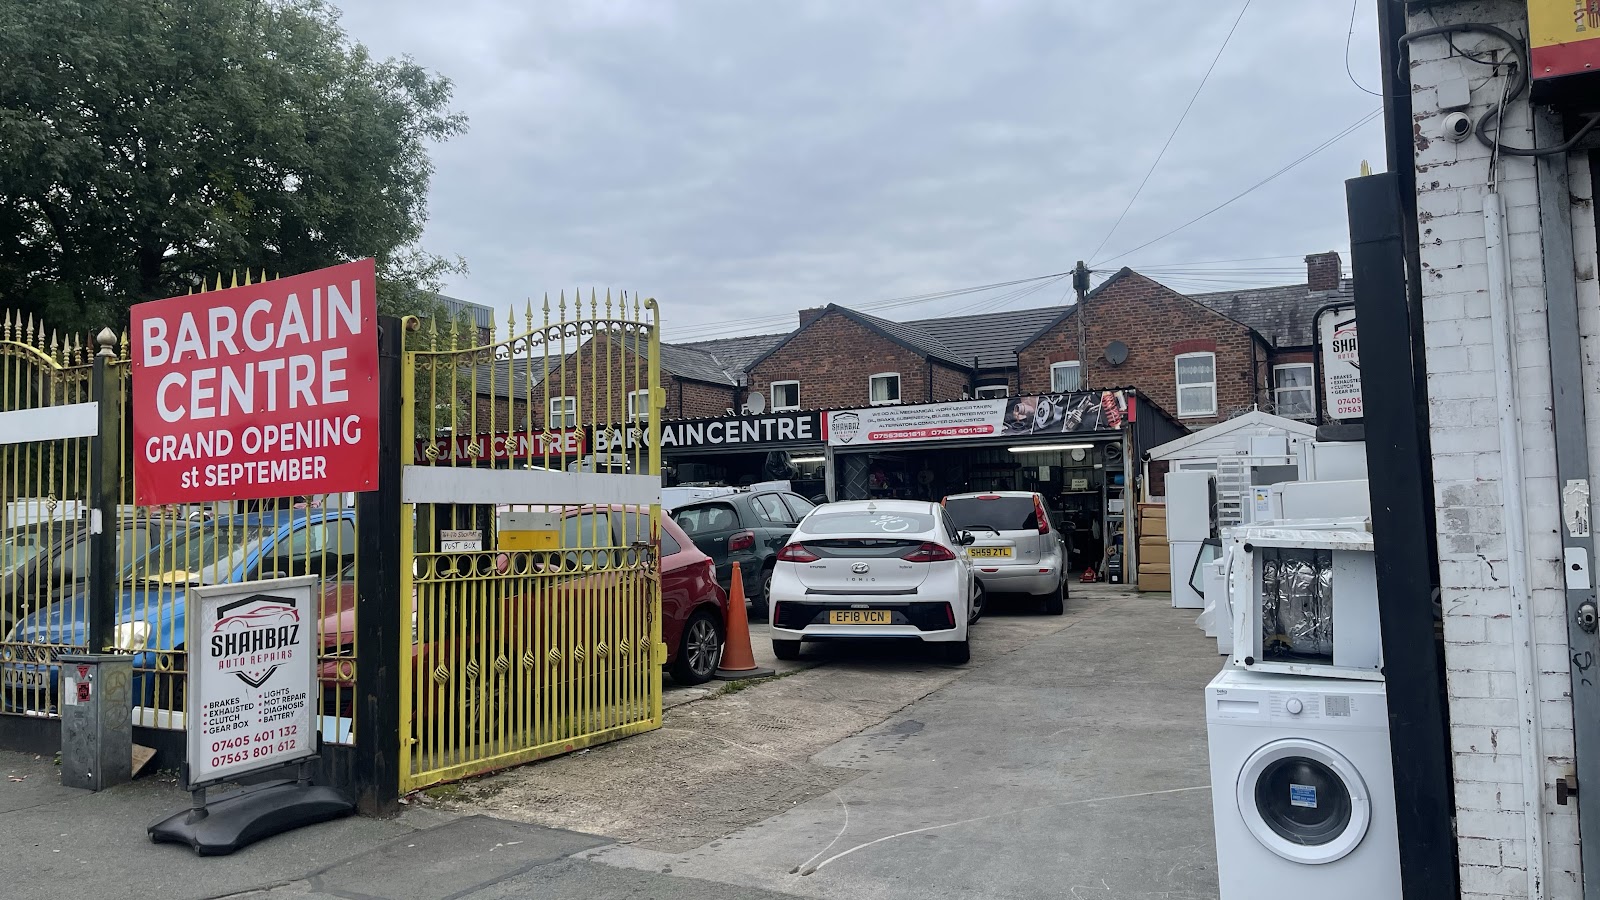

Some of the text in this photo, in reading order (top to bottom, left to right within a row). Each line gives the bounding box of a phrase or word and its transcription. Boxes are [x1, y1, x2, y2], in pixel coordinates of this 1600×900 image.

[142, 280, 362, 368] BARGAIN
[1333, 338, 1356, 353] SHA
[156, 347, 348, 422] CENTRE
[832, 422, 860, 431] SHAHBAZ
[146, 415, 361, 464] GRAND OPENING
[414, 431, 577, 462] ARGAIN CENTRE
[181, 455, 326, 489] st SEPTEMBER
[836, 612, 884, 621] EF18 VCN
[212, 624, 300, 658] SHAHBAZ
[219, 650, 292, 670] AUTO REPAIRS
[264, 688, 290, 699] LIGHTS
[264, 693, 306, 707] MOT REPAIR
[210, 698, 240, 709] BRAKES
[210, 703, 254, 718] EXHAUSTED
[264, 701, 304, 715] DIAGNOSIS
[209, 714, 240, 726] CLUTCH
[264, 711, 295, 723] BATTERY
[209, 721, 249, 735] GEAR BOX
[212, 725, 297, 752] 07405 401 132
[212, 740, 295, 767] 07563 801 612
